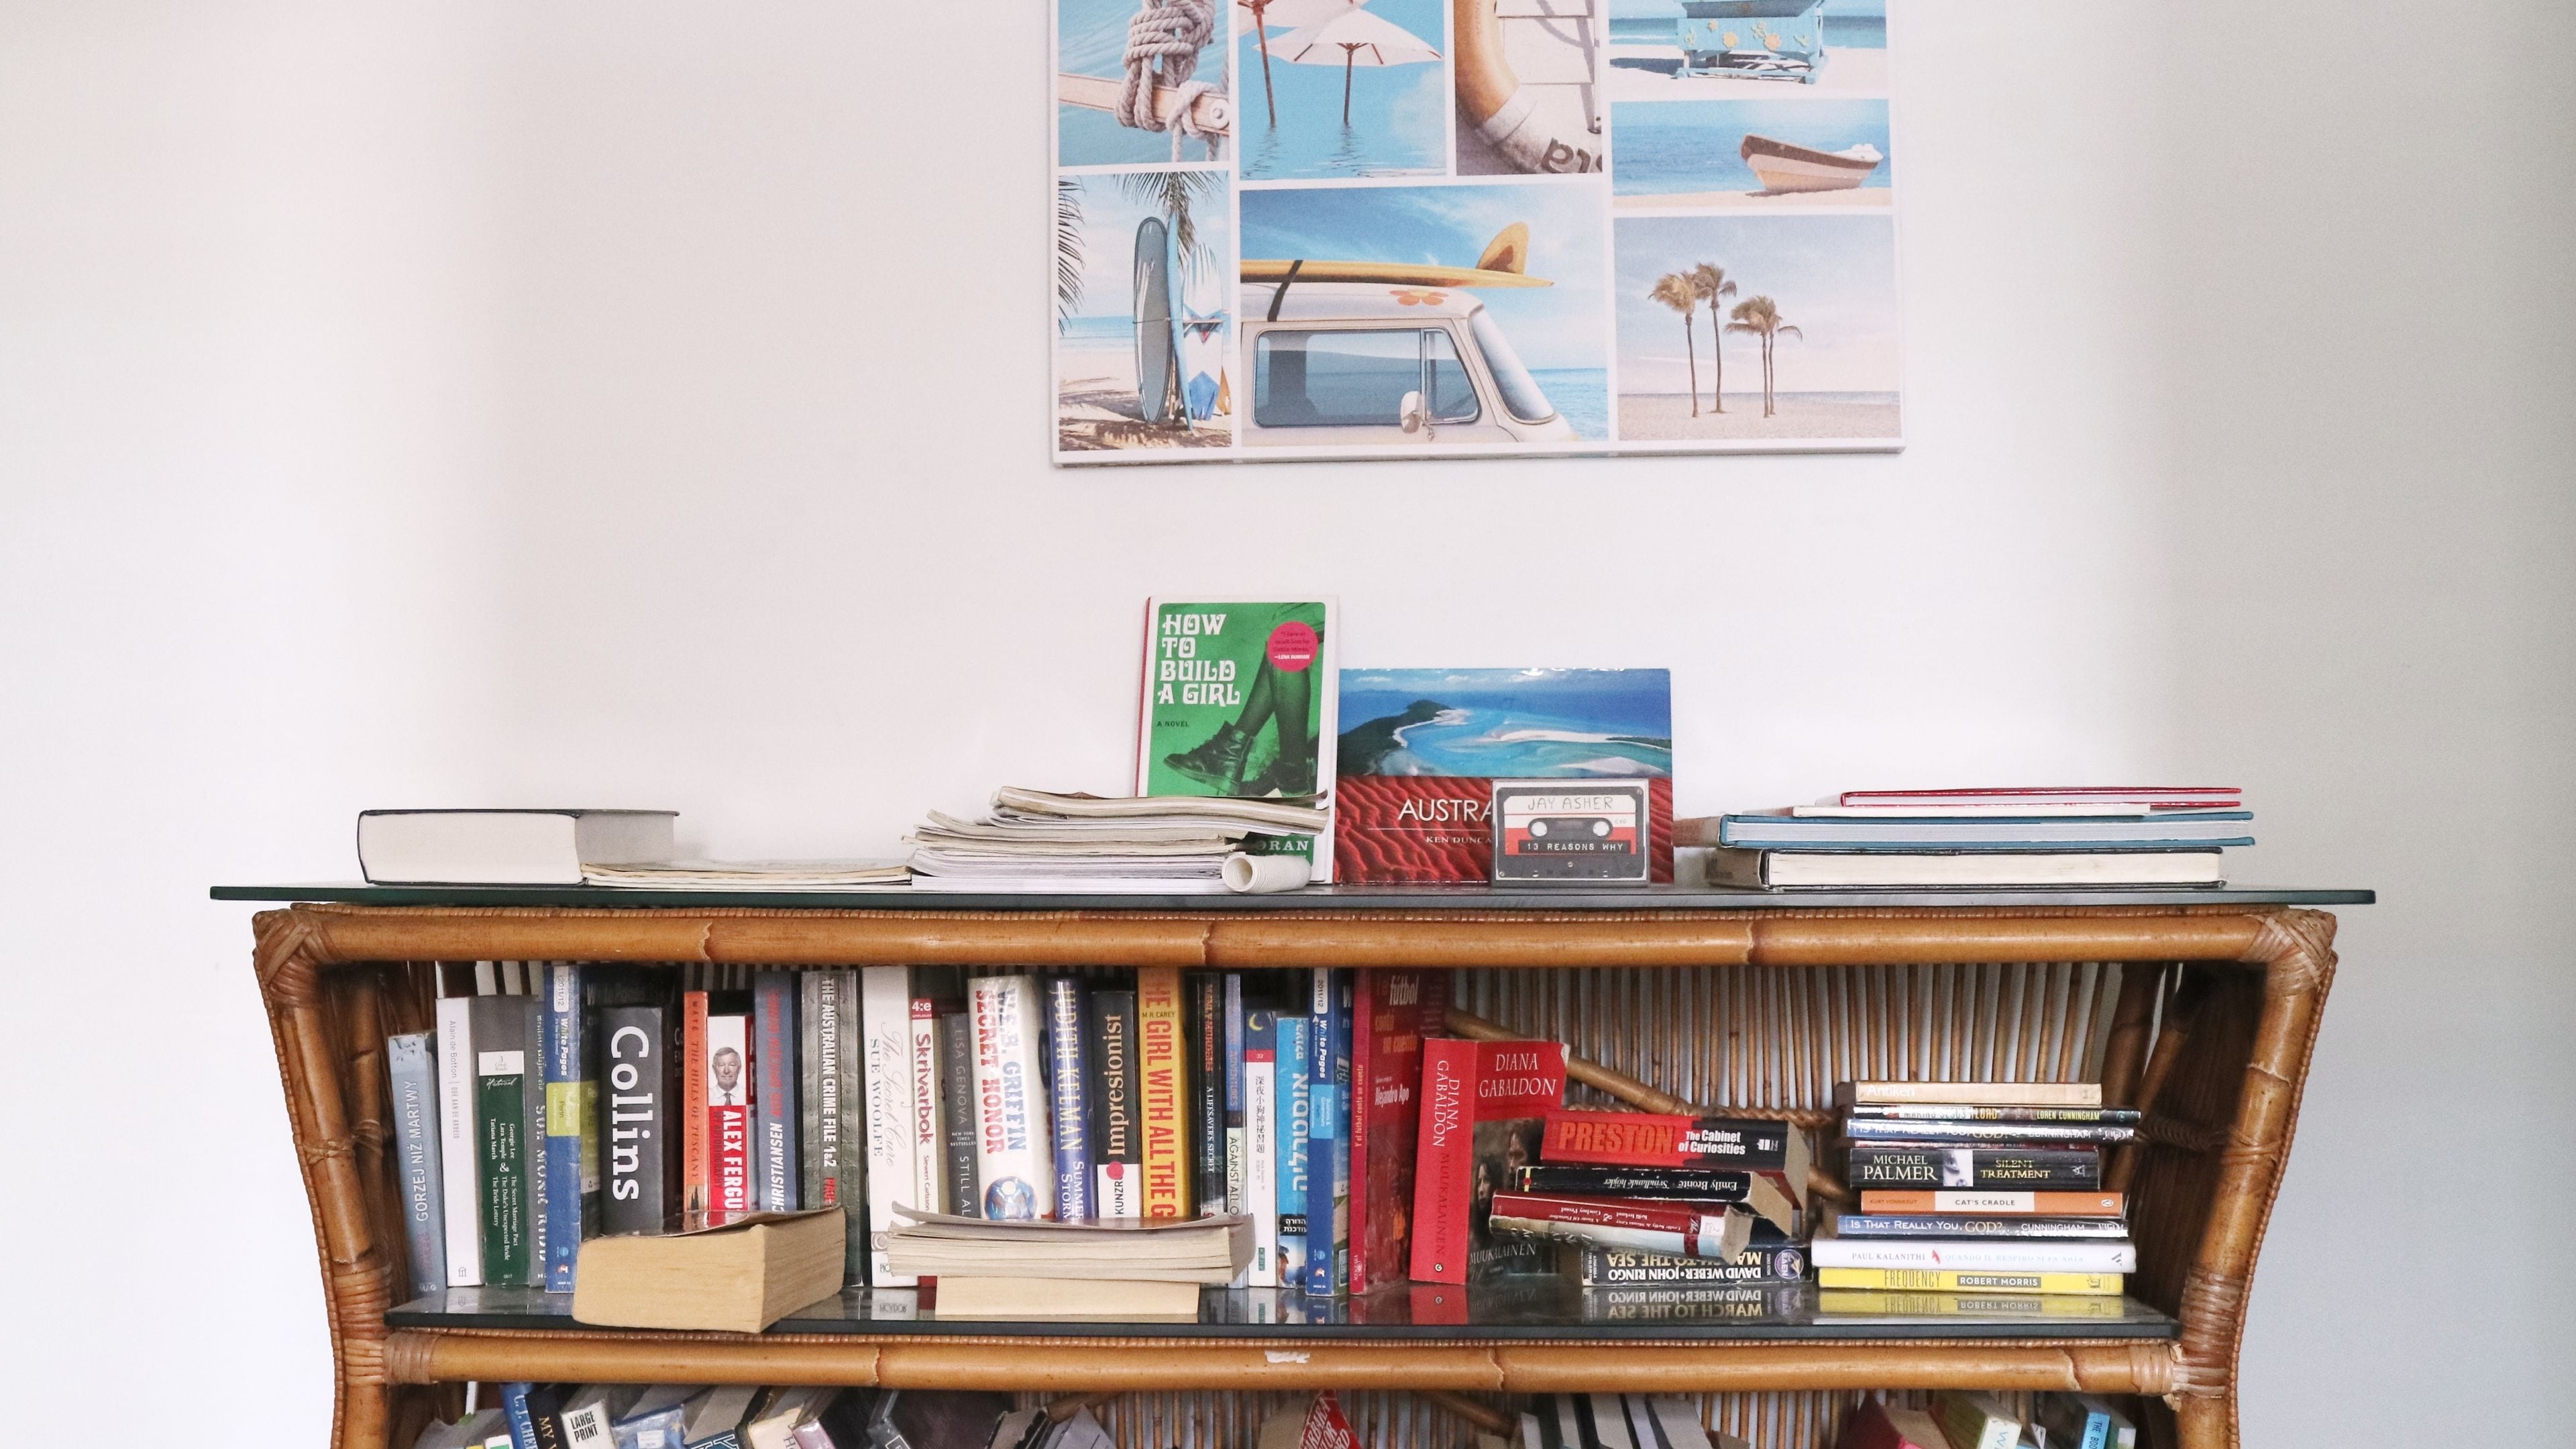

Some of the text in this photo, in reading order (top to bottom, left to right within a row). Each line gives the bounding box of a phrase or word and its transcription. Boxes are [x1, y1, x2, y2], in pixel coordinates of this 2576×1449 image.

[1162, 614, 1227, 635] HOW
[1162, 637, 1195, 658] TO
[1160, 660, 1236, 682] BUILD
[1157, 683, 1240, 707] A GIRL
[1527, 796, 1614, 811] JAY ASHER
[1527, 843, 1624, 851] 13 REASONS WHY
[557, 977, 565, 1006] 2011/12
[822, 978, 836, 1001] THE
[912, 1001, 932, 1012] 4:e
[450, 1041, 457, 1051] de
[559, 1018, 569, 1076] White Pages
[822, 1004, 837, 1074] AUSTRALIAN
[1318, 1020, 1328, 1078] White Pages
[451, 1053, 459, 1078] Botton
[975, 989, 1004, 1154] SECRET HONOR
[1049, 989, 1082, 1150] JUDITH KELMAN
[1495, 1053, 1538, 1071] DIANA
[953, 1029, 967, 1125] LISA GENOVA
[1229, 1051, 1238, 1106] ADVENTURES
[1479, 1077, 1557, 1097] GABALDON
[822, 1079, 837, 1114] CRIME
[870, 1038, 883, 1156] SUE WOOLFE
[881, 1022, 906, 1168] The Secret Cure
[916, 1034, 933, 1146] Skrivarbok
[1867, 1085, 1915, 1097] Antiken
[405, 1081, 422, 1139] MARTWY
[610, 1025, 653, 1201] Collins
[692, 1106, 699, 1120] OF
[1002, 1061, 1026, 1150] GRIFFIN
[1146, 1020, 1176, 1199] GIRL WITH ALL THE
[1433, 1059, 1450, 1148] GABALDON
[1446, 1078, 1460, 1130] DIANA
[2037, 1111, 2100, 1120] LOREN CUNNINGHAM
[723, 1110, 743, 1152] ALEX
[823, 1118, 837, 1142] FILE
[1287, 1072, 1309, 1191] אוסטרליה
[1558, 1121, 1676, 1155] PRESTON
[1685, 1130, 1741, 1143] The Cabinet
[499, 1138, 507, 1160] Temple
[692, 1125, 700, 1179] TUSCANY
[713, 1126, 722, 1189] AUTOBIOGRAPHY
[1678, 1142, 1746, 1155] of Curiosities
[1873, 1155, 1928, 1165] MICHAEL
[769, 1123, 784, 1212] CHRISTIANSEN
[959, 1155, 969, 1192] STILL
[1229, 1136, 1240, 1203] AGAINST ALL
[1863, 1165, 1938, 1181] PALMER
[1980, 1169, 2051, 1179] TREATMENT
[1995, 1159, 2035, 1169] SILENT
[412, 1169, 430, 1222] GORZEJ
[1114, 1177, 1124, 1215] KUNZR
[1628, 1179, 1668, 1189] Svindlande
[1711, 1180, 1738, 1191] Emily
[1435, 1152, 1450, 1255] MUUKALAINEN
[501, 1210, 509, 1244] Unexpected
[1863, 1220, 1890, 1230] THAT
[1894, 1220, 1935, 1230] REALLY
[1964, 1220, 2003, 1234] GOD?
[1468, 1243, 1536, 1265] MUUKALAINEN
[1606, 1253, 1636, 1267] SEA
[1780, 1252, 1788, 1277] BAEN
[1851, 1252, 1926, 1260] PAUL KALANITHI
[1608, 1265, 1762, 1281] DAVID WEBER JOHN RINGO
[1883, 1270, 1942, 1288] FREQUENCY
[1960, 1277, 2038, 1287] ROBERT MORRIS
[539, 1416, 555, 1439] MY
[570, 1411, 596, 1431] LARGE
[2092, 1421, 2103, 1434] THE
[574, 1424, 598, 1444] PRINT
